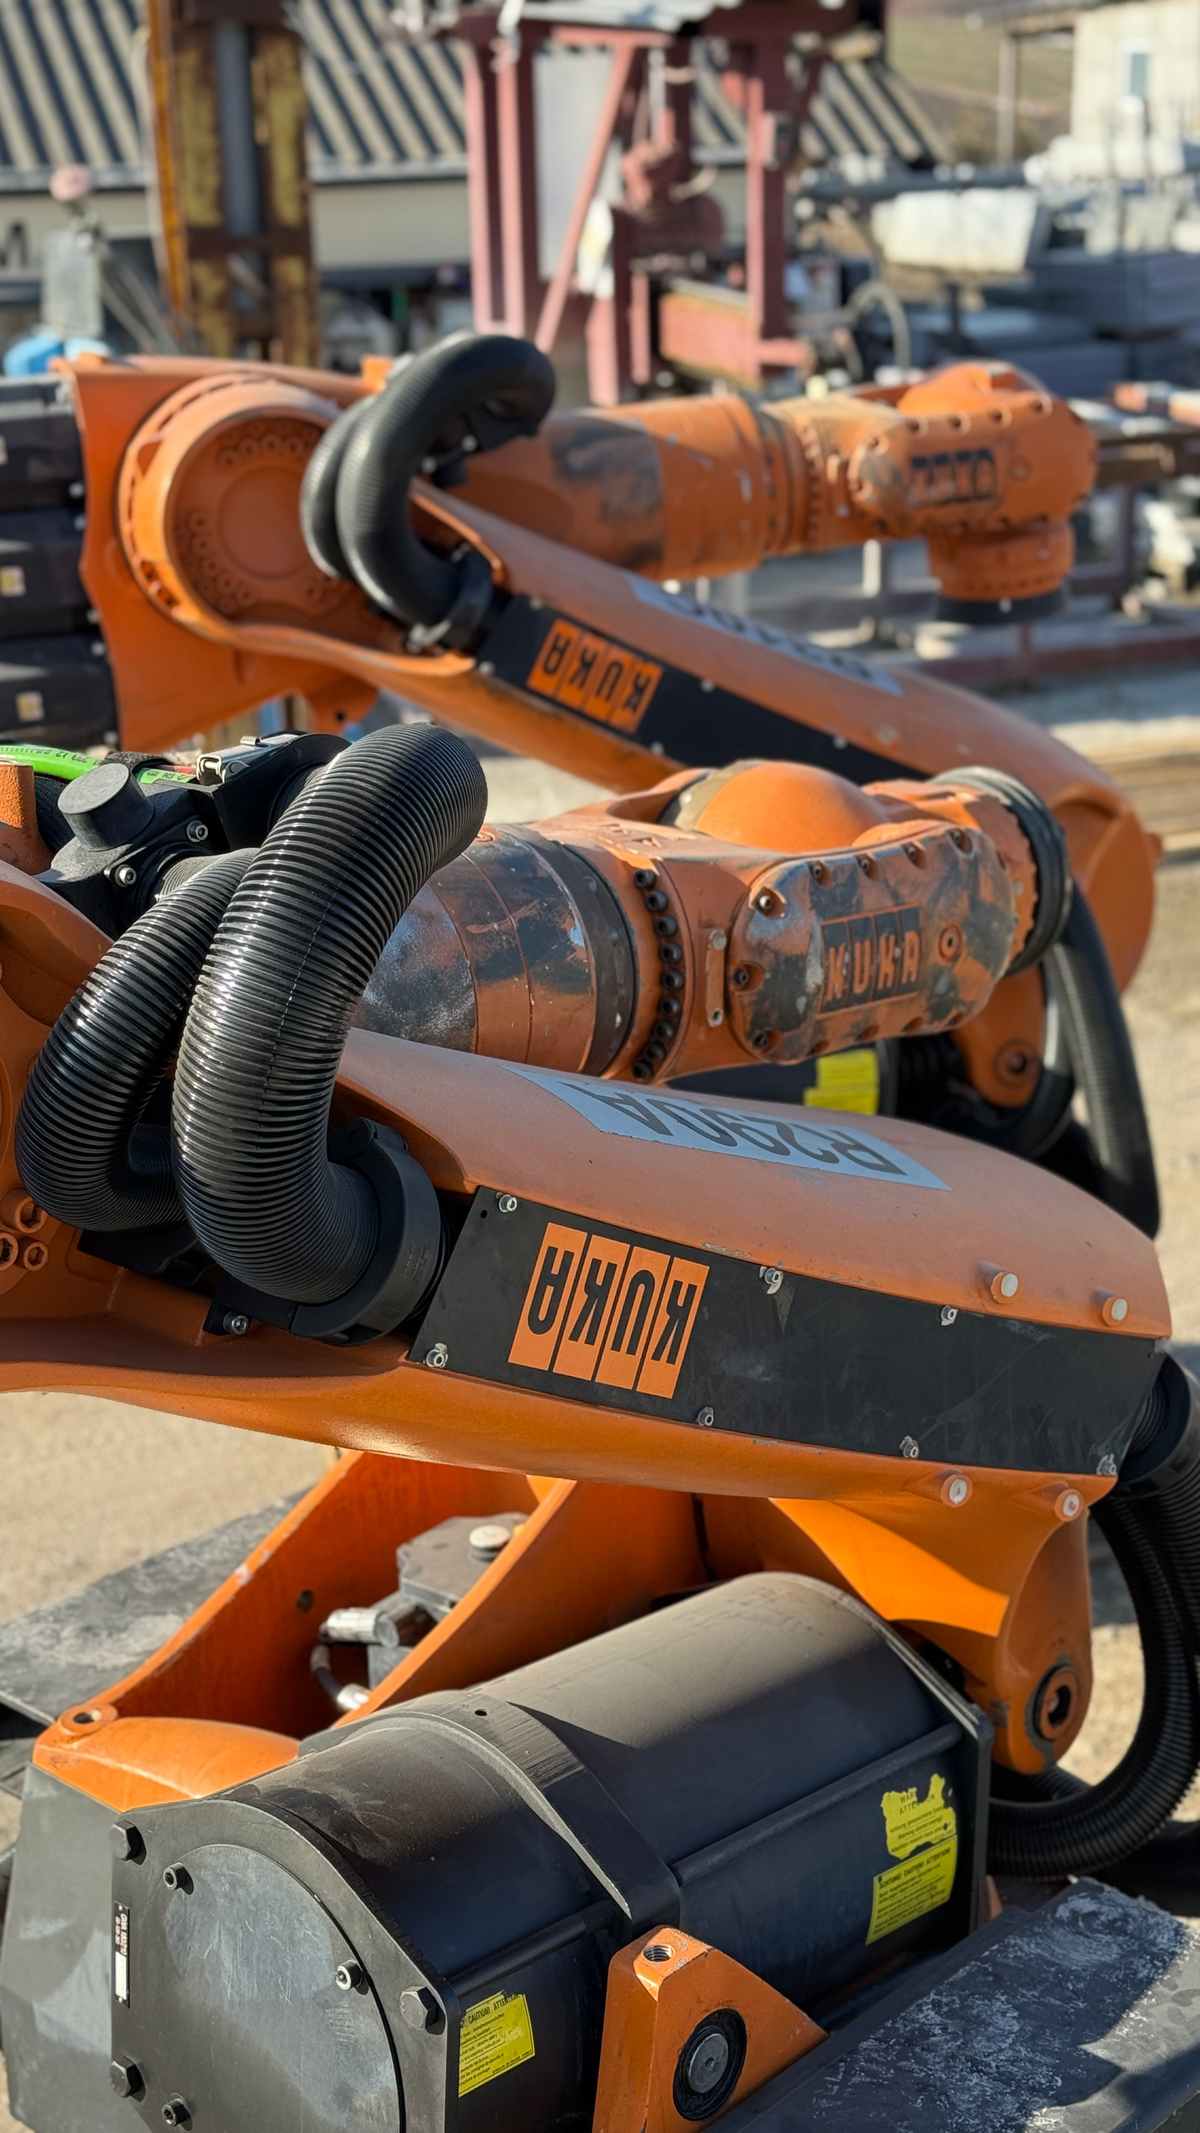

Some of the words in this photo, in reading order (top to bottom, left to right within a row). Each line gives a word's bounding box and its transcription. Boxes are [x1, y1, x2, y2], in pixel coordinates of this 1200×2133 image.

[541, 631, 653, 716] KUKA
[823, 928, 920, 1003] KUKA
[524, 1242, 701, 1369] KUKA
